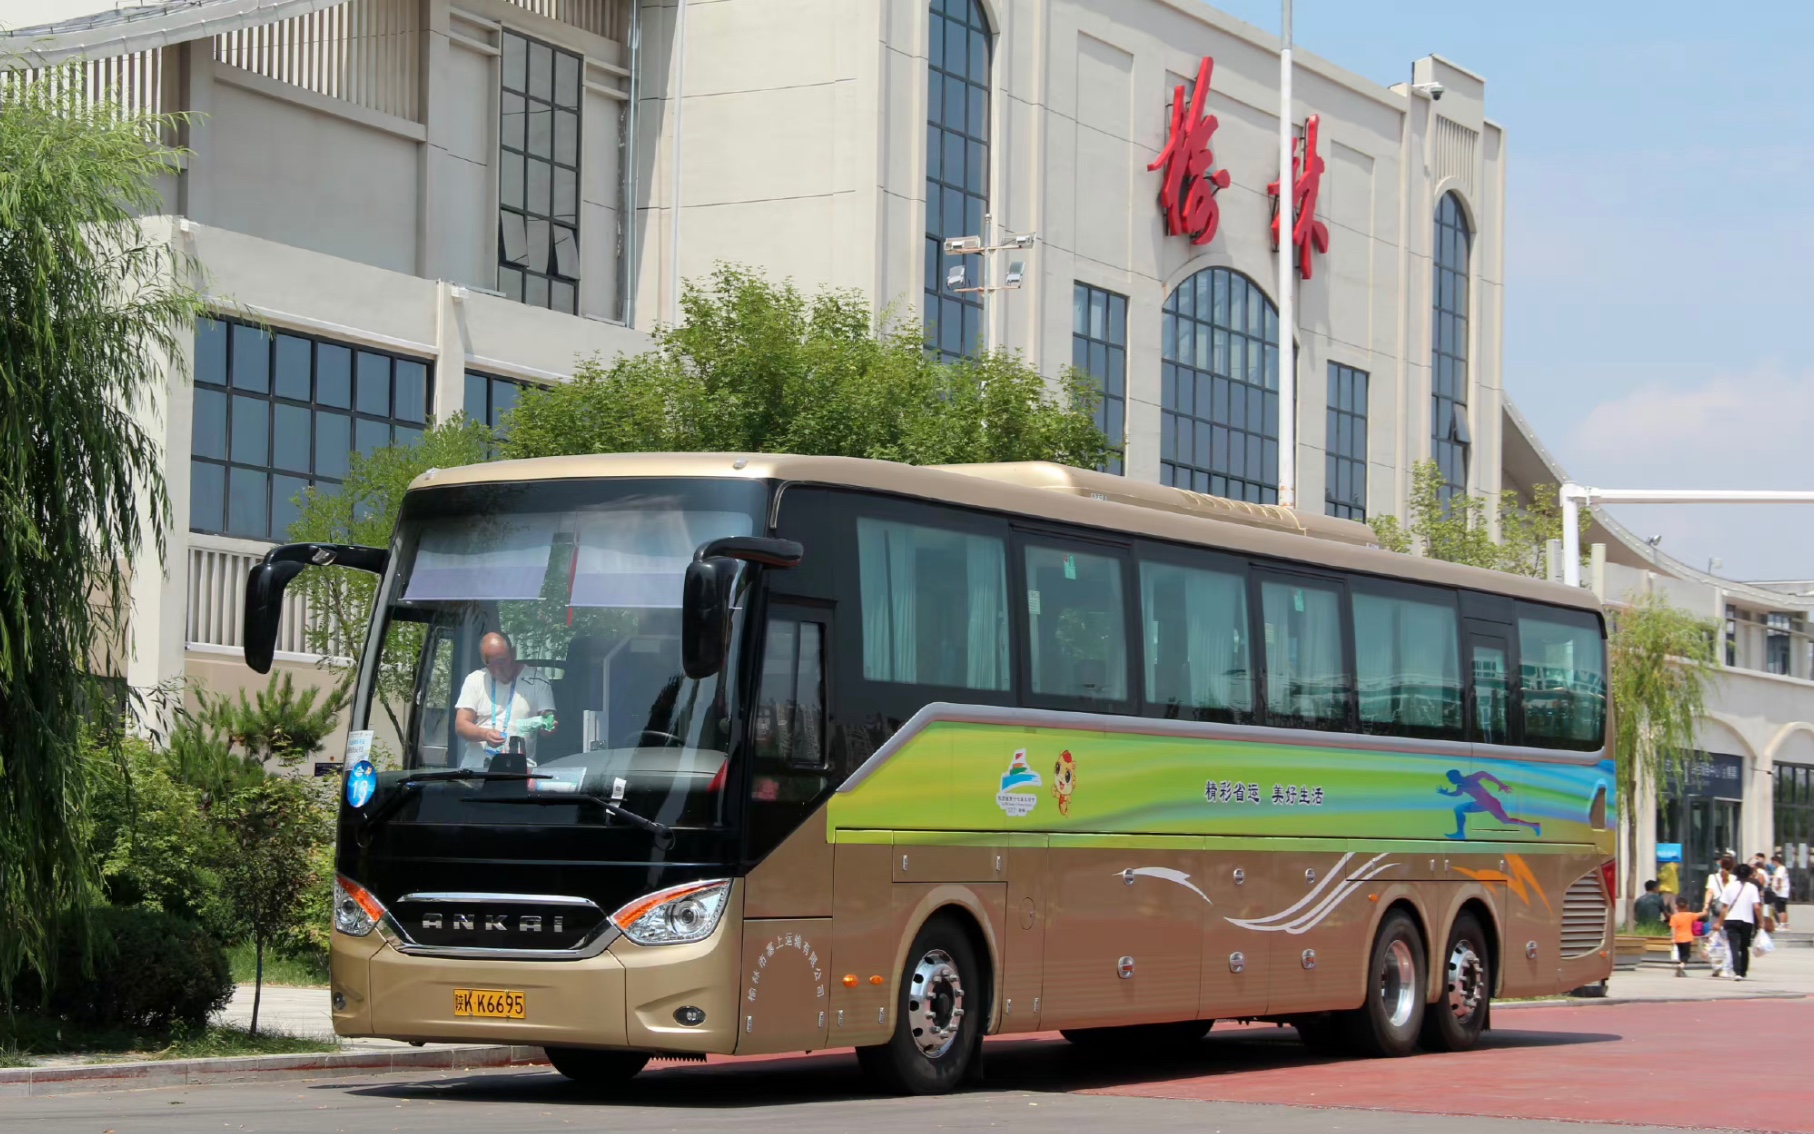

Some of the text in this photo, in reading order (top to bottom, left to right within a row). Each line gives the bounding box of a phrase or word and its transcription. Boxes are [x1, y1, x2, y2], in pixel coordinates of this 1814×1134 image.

[1205, 780, 1324, 805] 精彩省运 美好生活
[421, 912, 564, 933] ANKAI
